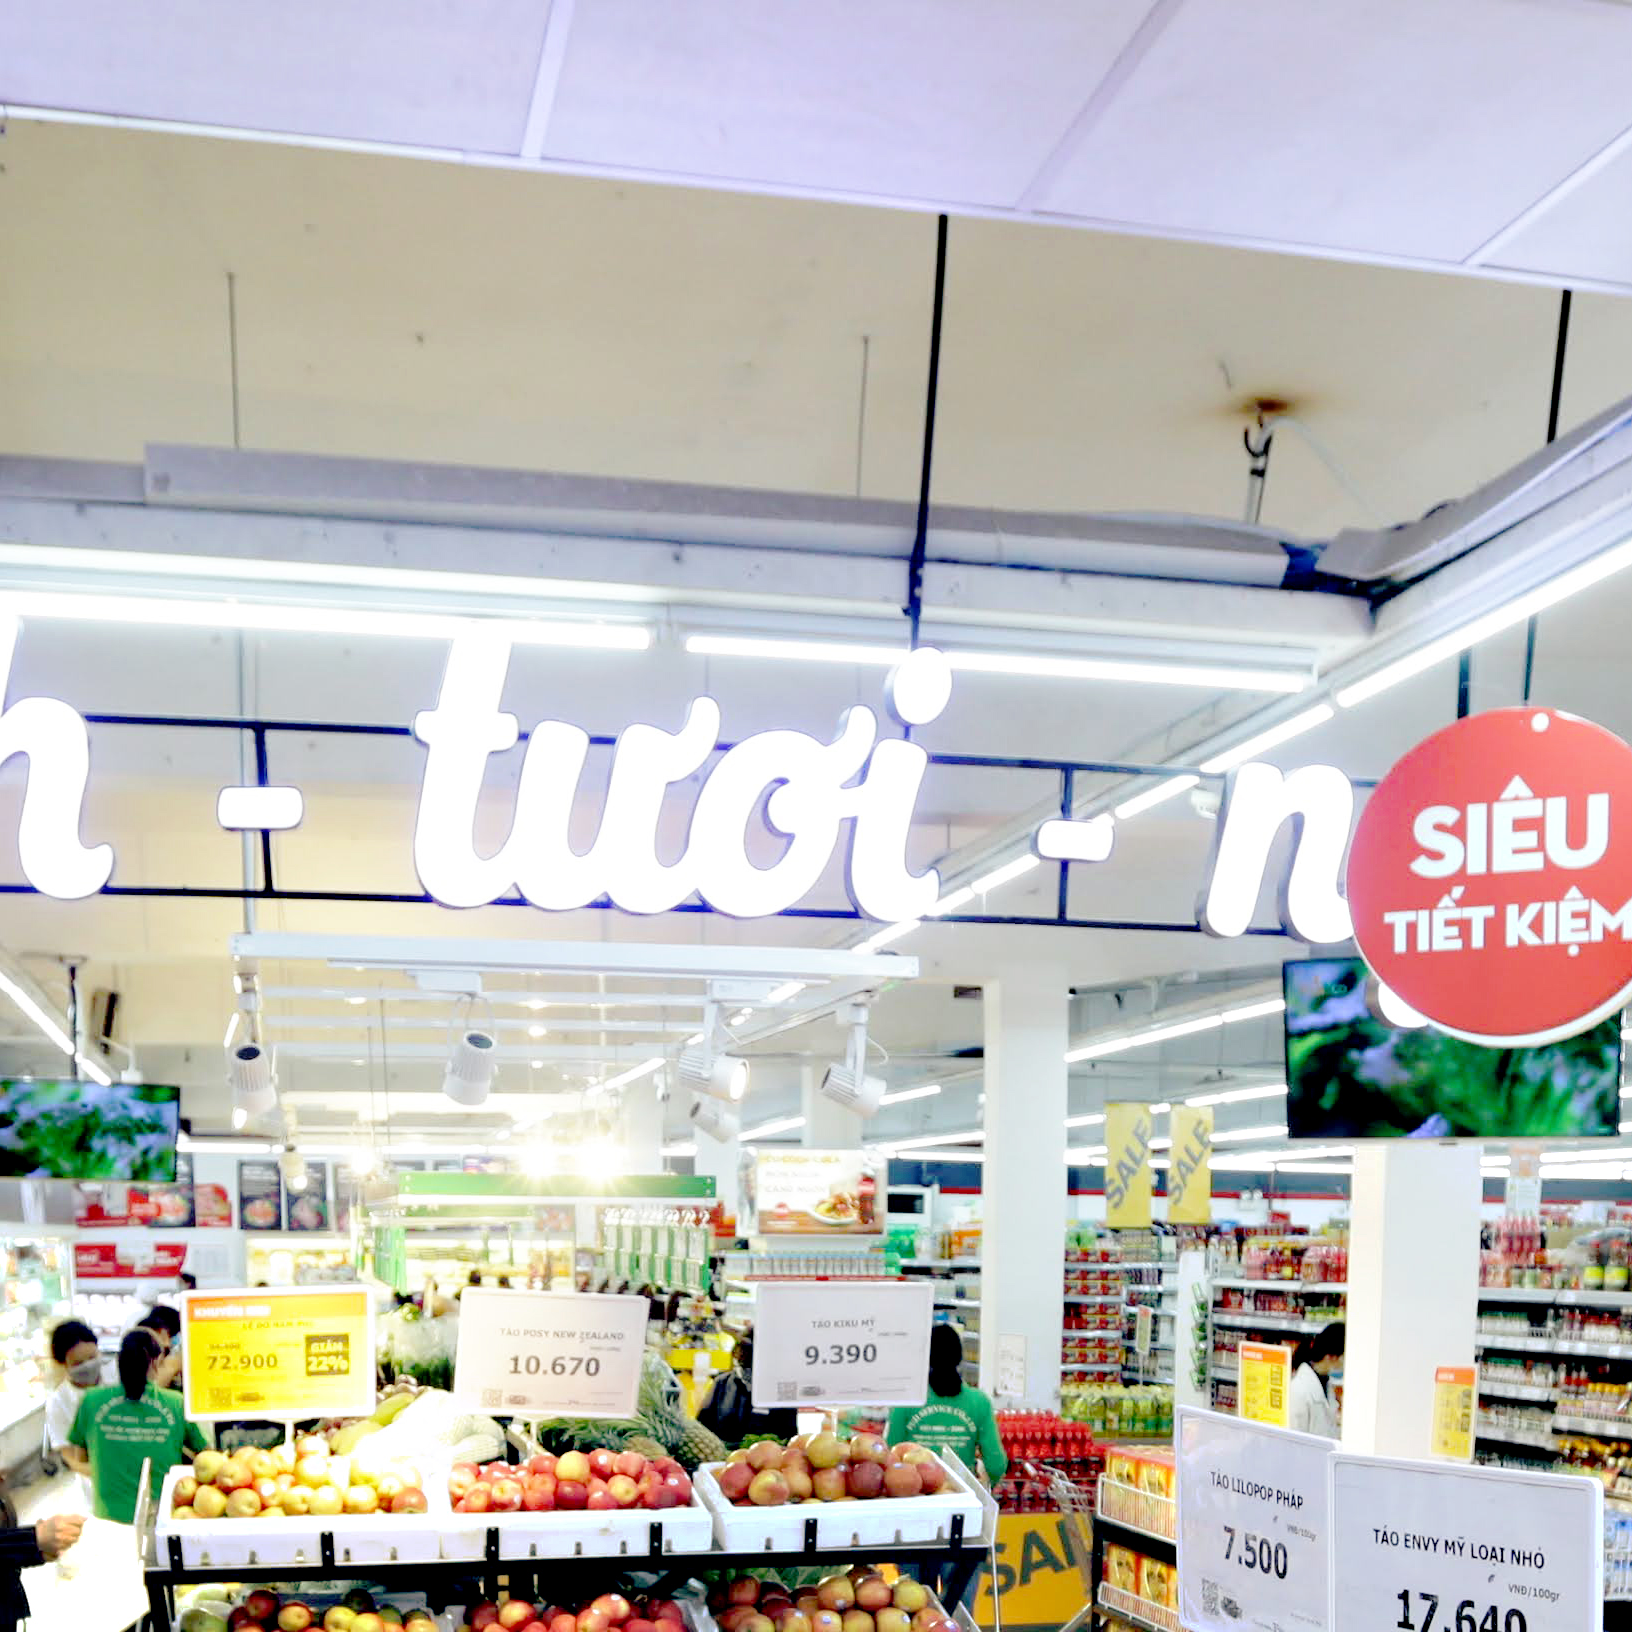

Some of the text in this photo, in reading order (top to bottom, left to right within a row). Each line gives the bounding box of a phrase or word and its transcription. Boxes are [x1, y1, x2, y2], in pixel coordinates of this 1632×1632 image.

[412, 633, 942, 922] tươi
[1410, 778, 1609, 877] SIÊU
[1383, 896, 1495, 955] TIẾT
[1106, 1109, 1151, 1206] SALE
[1169, 1119, 1212, 1209] SALE
[207, 1354, 278, 1371] 72.900
[308, 1356, 348, 1372] 22%
[508, 1355, 600, 1377] 10.670
[804, 1343, 877, 1366] 9.390
[1210, 1470, 1304, 1511] TÁO LILOPOP PHÁP
[1223, 1525, 1288, 1580] 7.500
[1373, 1526, 1546, 1570] TÁO ENVY MỸ LOẠI NHỎ
